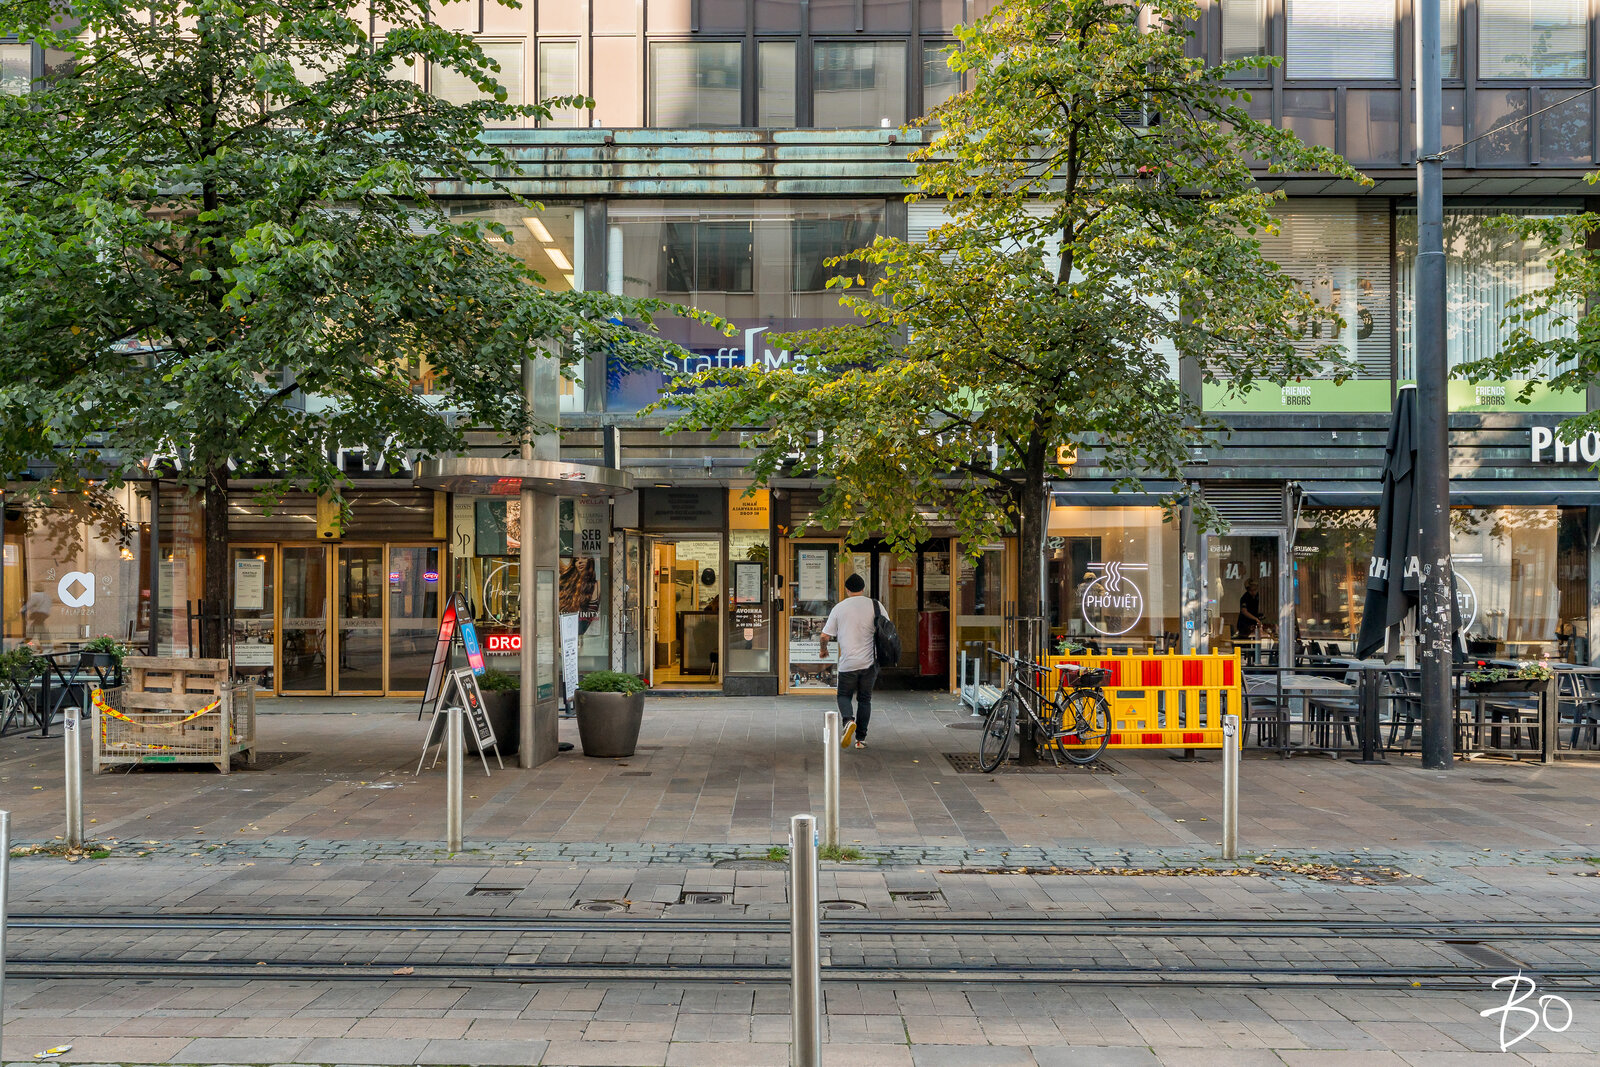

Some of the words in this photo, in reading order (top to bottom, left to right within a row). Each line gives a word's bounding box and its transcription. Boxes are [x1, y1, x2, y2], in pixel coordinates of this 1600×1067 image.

[663, 348, 739, 376] Staff
[1281, 386, 1311, 396] FRIENDS
[1475, 386, 1505, 396] FRIENDS
[1287, 396, 1311, 406] BRGRS
[1481, 396, 1505, 406] BRGRS
[582, 529, 602, 541] SEB
[582, 541, 601, 550] MAN
[490, 582, 513, 600] Hair
[1113, 593, 1138, 611] VIỆT
